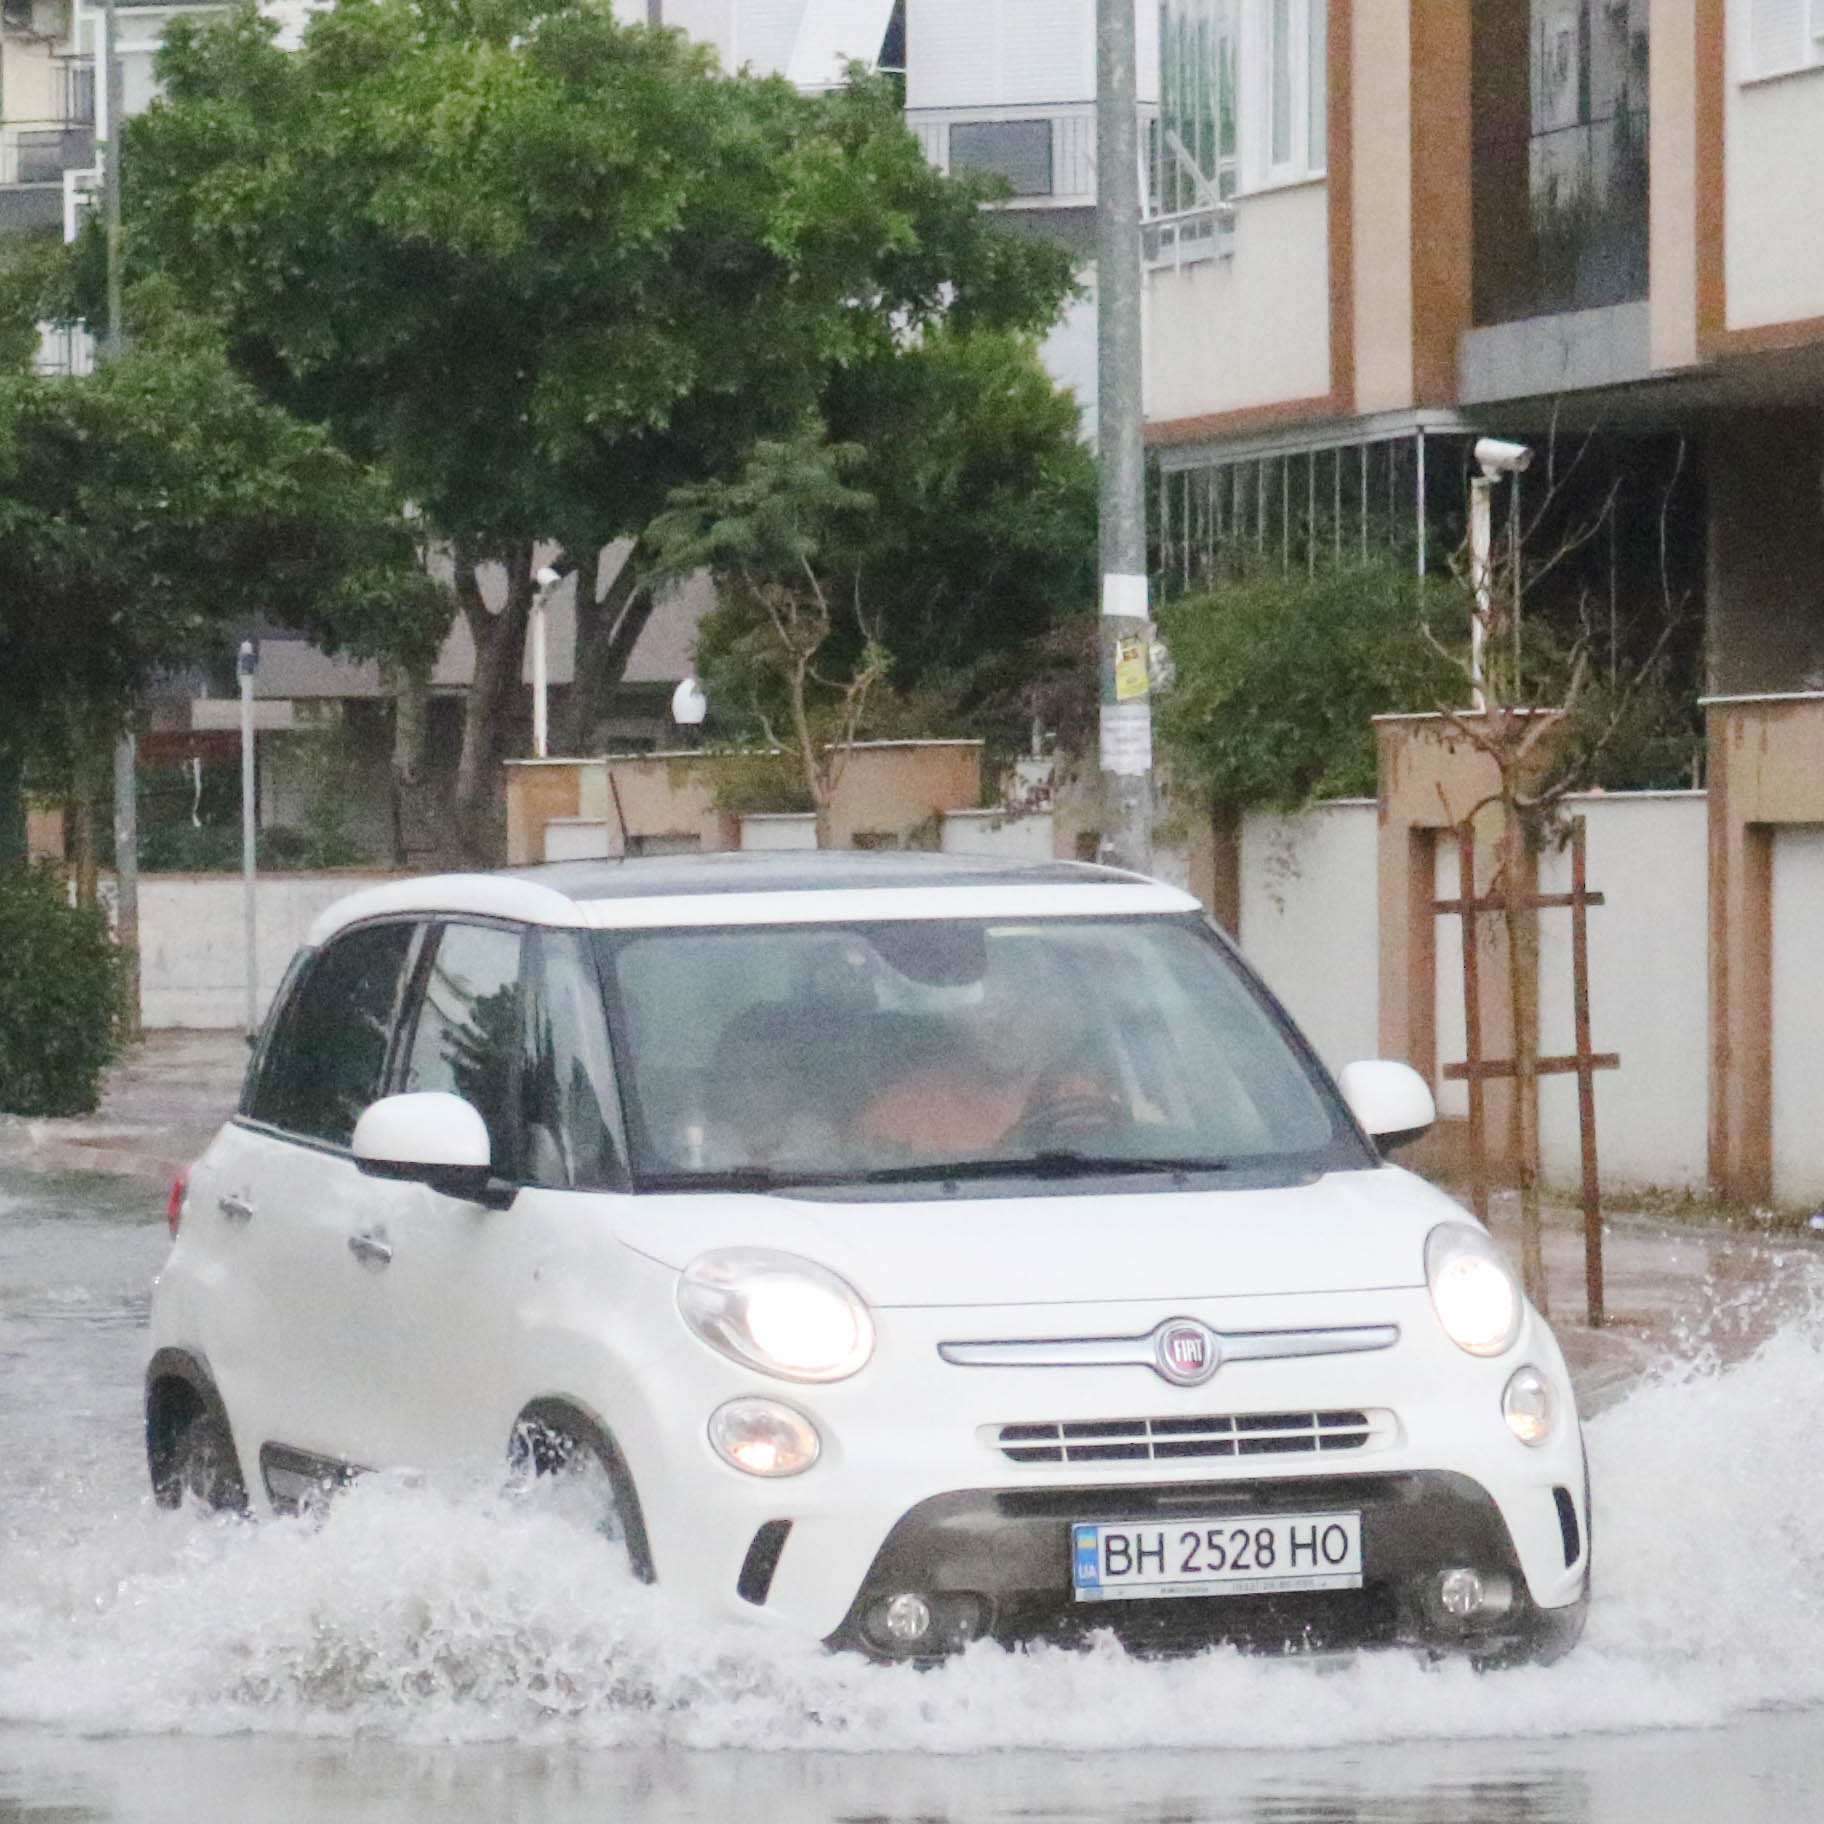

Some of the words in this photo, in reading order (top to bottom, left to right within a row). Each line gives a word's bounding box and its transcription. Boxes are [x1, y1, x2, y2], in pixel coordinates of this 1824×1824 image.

[1173, 1339, 1202, 1362] FIAT
[1104, 1532, 1166, 1577] BH
[1179, 1527, 1276, 1573] 2528
[1289, 1523, 1349, 1568] HO
